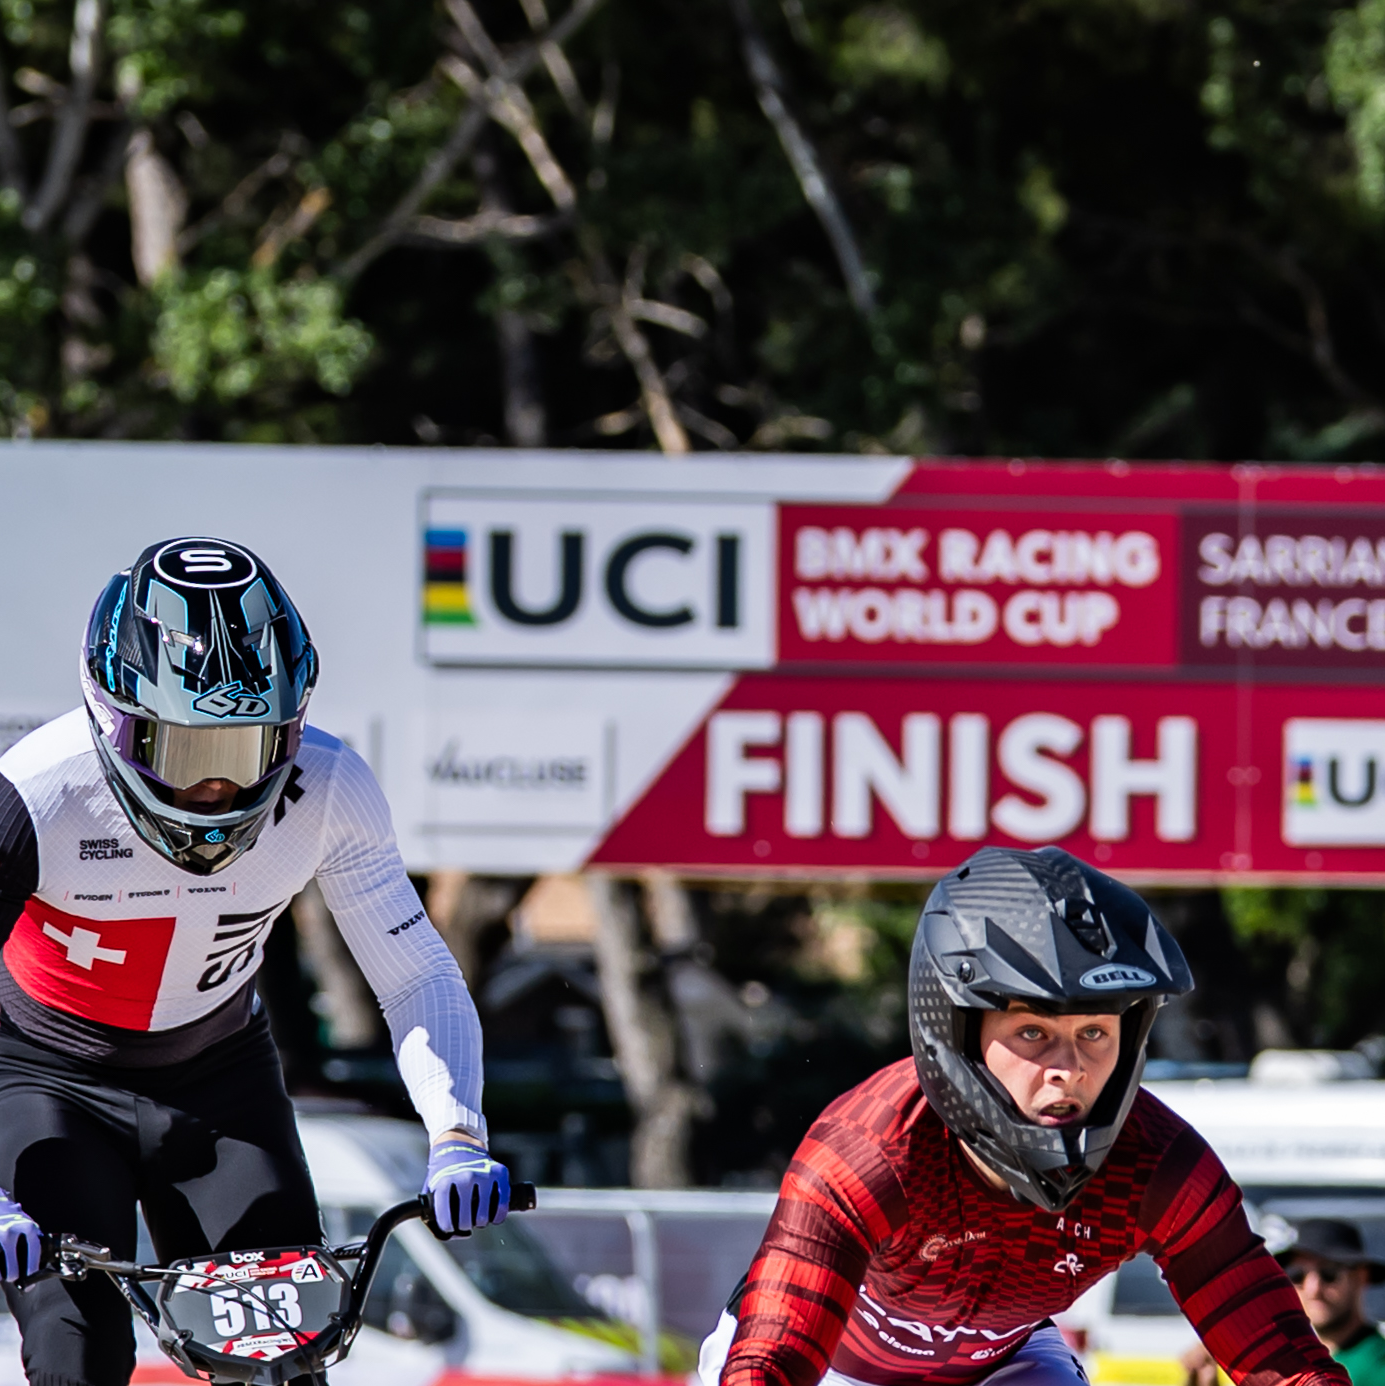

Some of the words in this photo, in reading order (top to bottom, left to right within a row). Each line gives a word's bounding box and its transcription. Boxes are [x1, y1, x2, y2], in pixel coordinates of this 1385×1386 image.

[794, 527, 927, 582] BMX
[940, 530, 1159, 587] RACING
[489, 530, 739, 630] UCI
[793, 590, 996, 644] WORLD
[1005, 591, 1120, 646] CUP
[705, 711, 1200, 843] FINISH
[79, 838, 119, 850] SWISS
[79, 848, 133, 861] CYCLING
[74, 893, 113, 901] EVIDEN
[135, 890, 163, 898] TUDOR
[187, 886, 227, 894] VOLVO
[1092, 970, 1146, 985] BELL
[230, 1251, 266, 1264] box
[225, 1270, 246, 1279] UCI
[301, 1264, 318, 1280] A
[210, 1283, 303, 1337] 513
